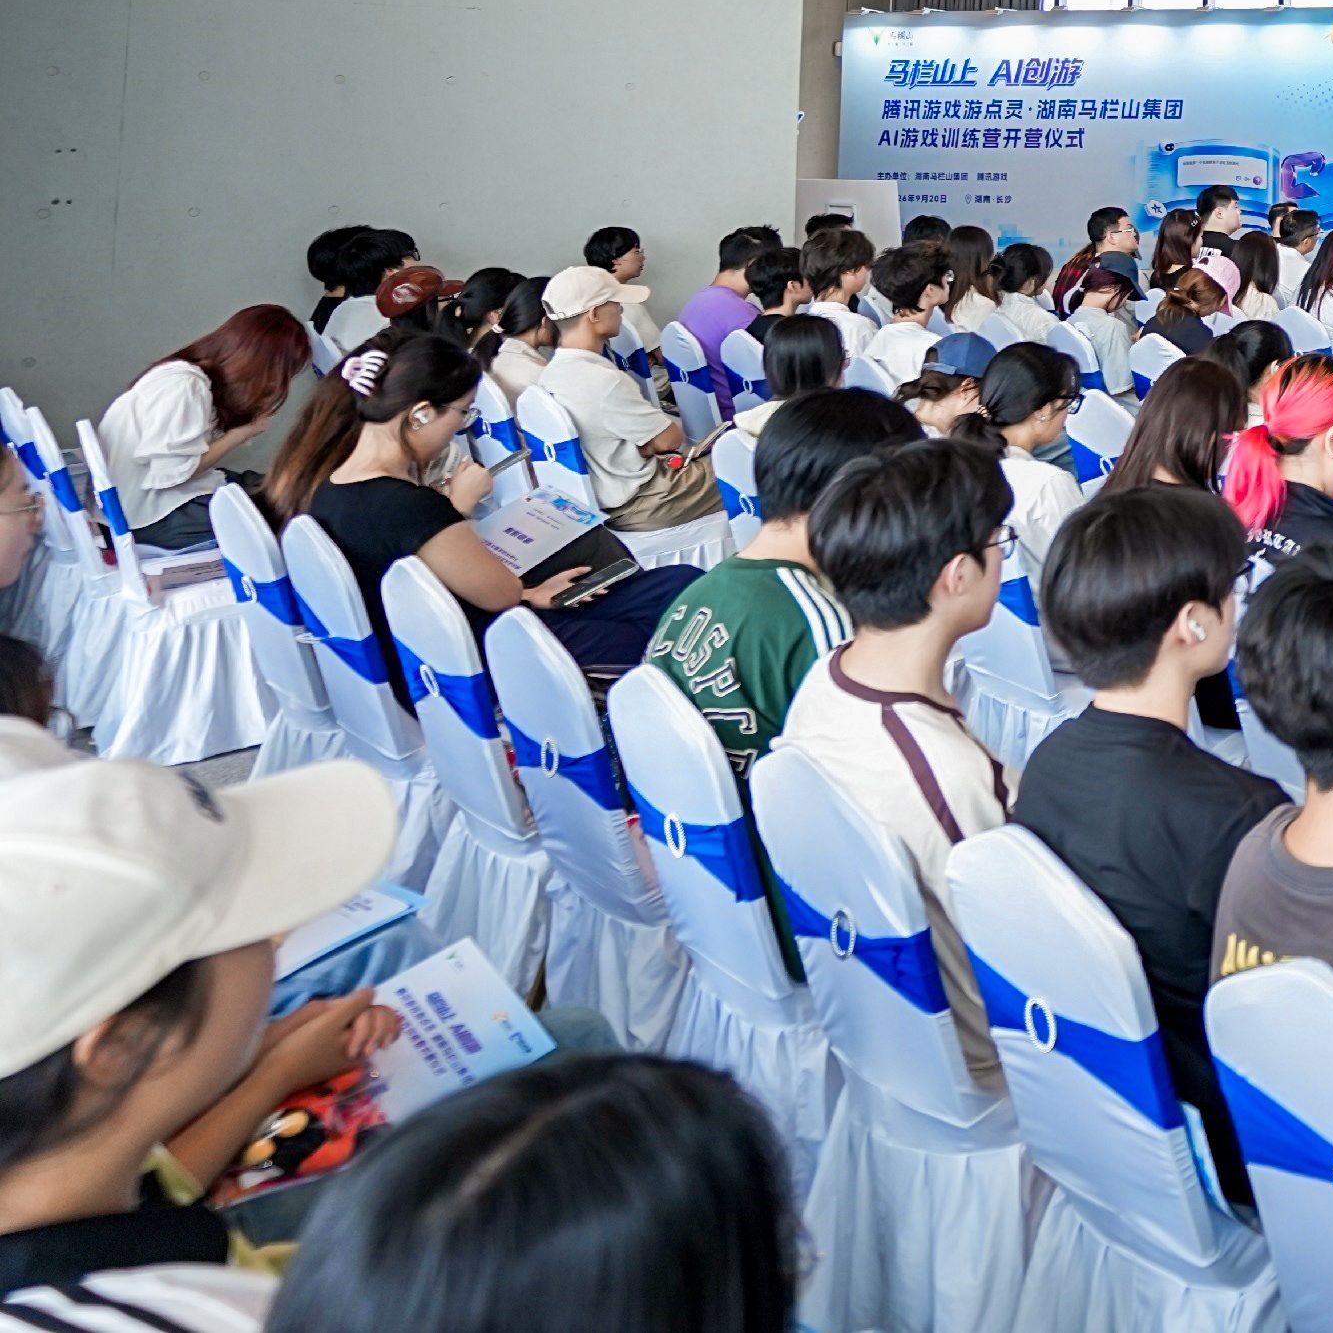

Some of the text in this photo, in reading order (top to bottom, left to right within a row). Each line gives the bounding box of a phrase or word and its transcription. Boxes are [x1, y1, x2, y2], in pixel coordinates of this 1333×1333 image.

[884, 57, 1085, 91] 马栏山上 AI创游
[878, 127, 1085, 149] AI游戏训练营开营仪式
[977, 172, 1008, 182] 腾讯游戏
